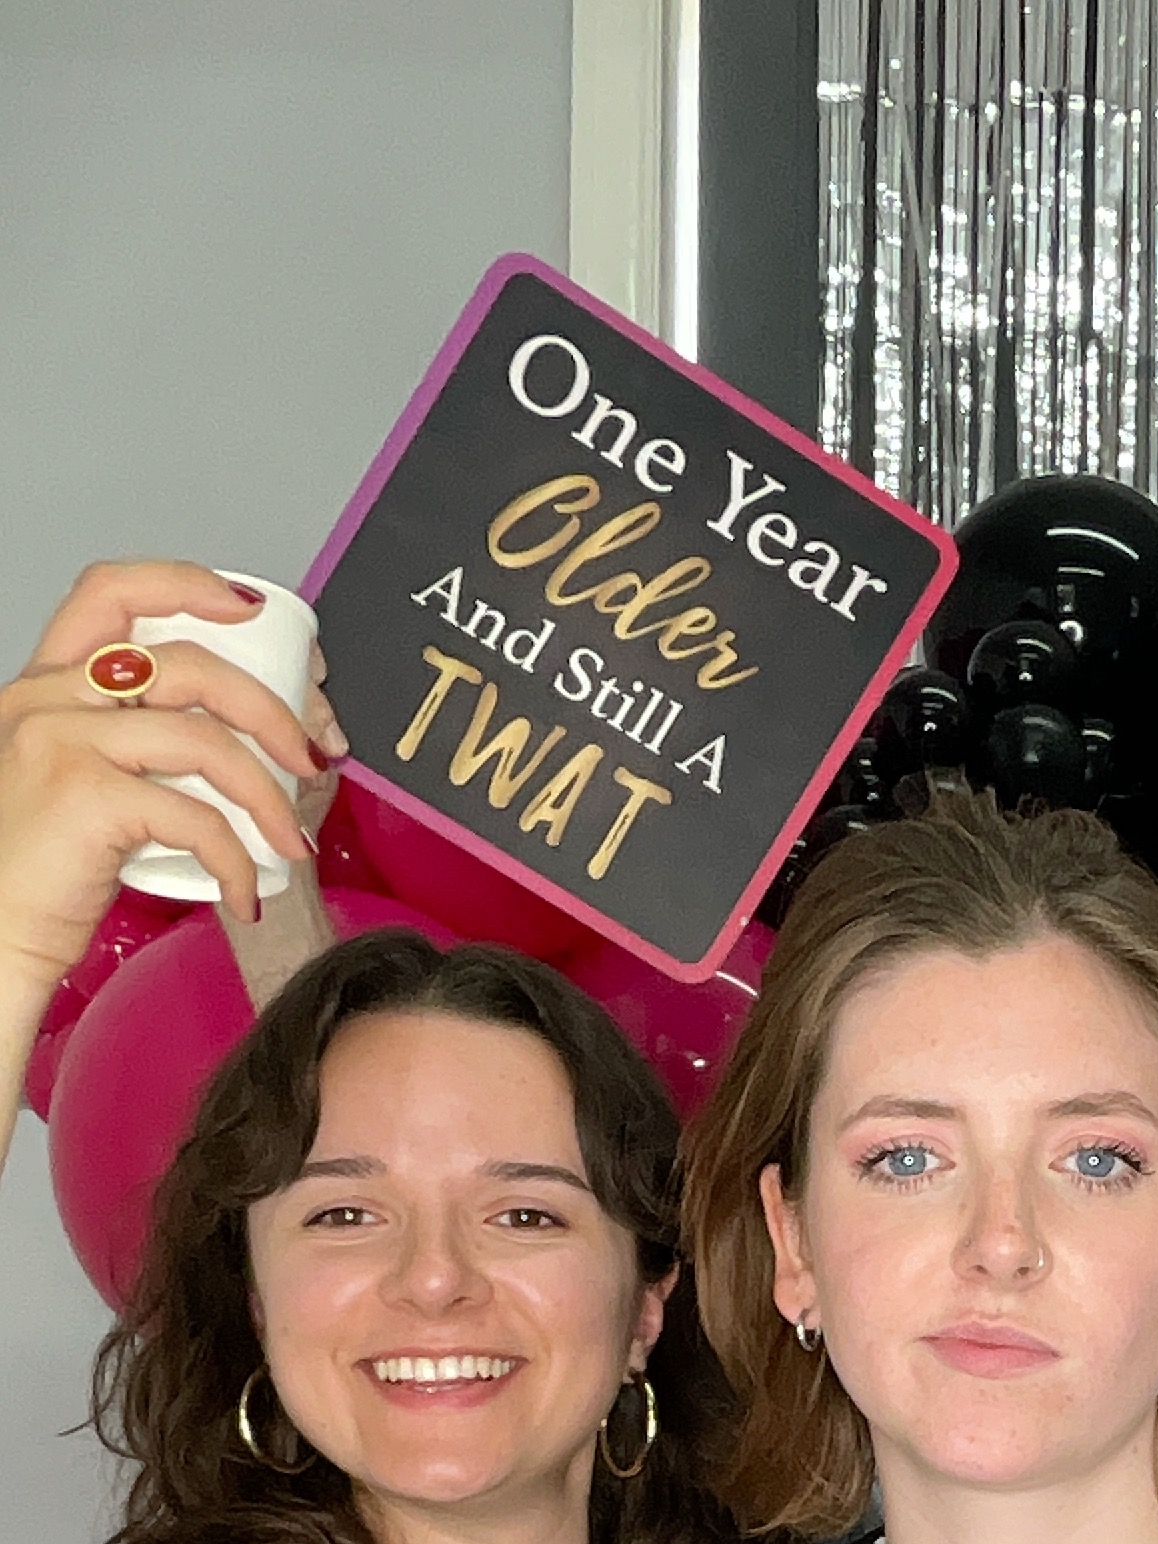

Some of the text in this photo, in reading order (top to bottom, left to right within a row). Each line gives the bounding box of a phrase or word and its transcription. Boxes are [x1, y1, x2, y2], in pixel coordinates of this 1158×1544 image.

[486, 473, 760, 691] Older
[508, 334, 888, 622] One Year
[395, 645, 673, 880] TWAT
[410, 566, 727, 795] And Still A
